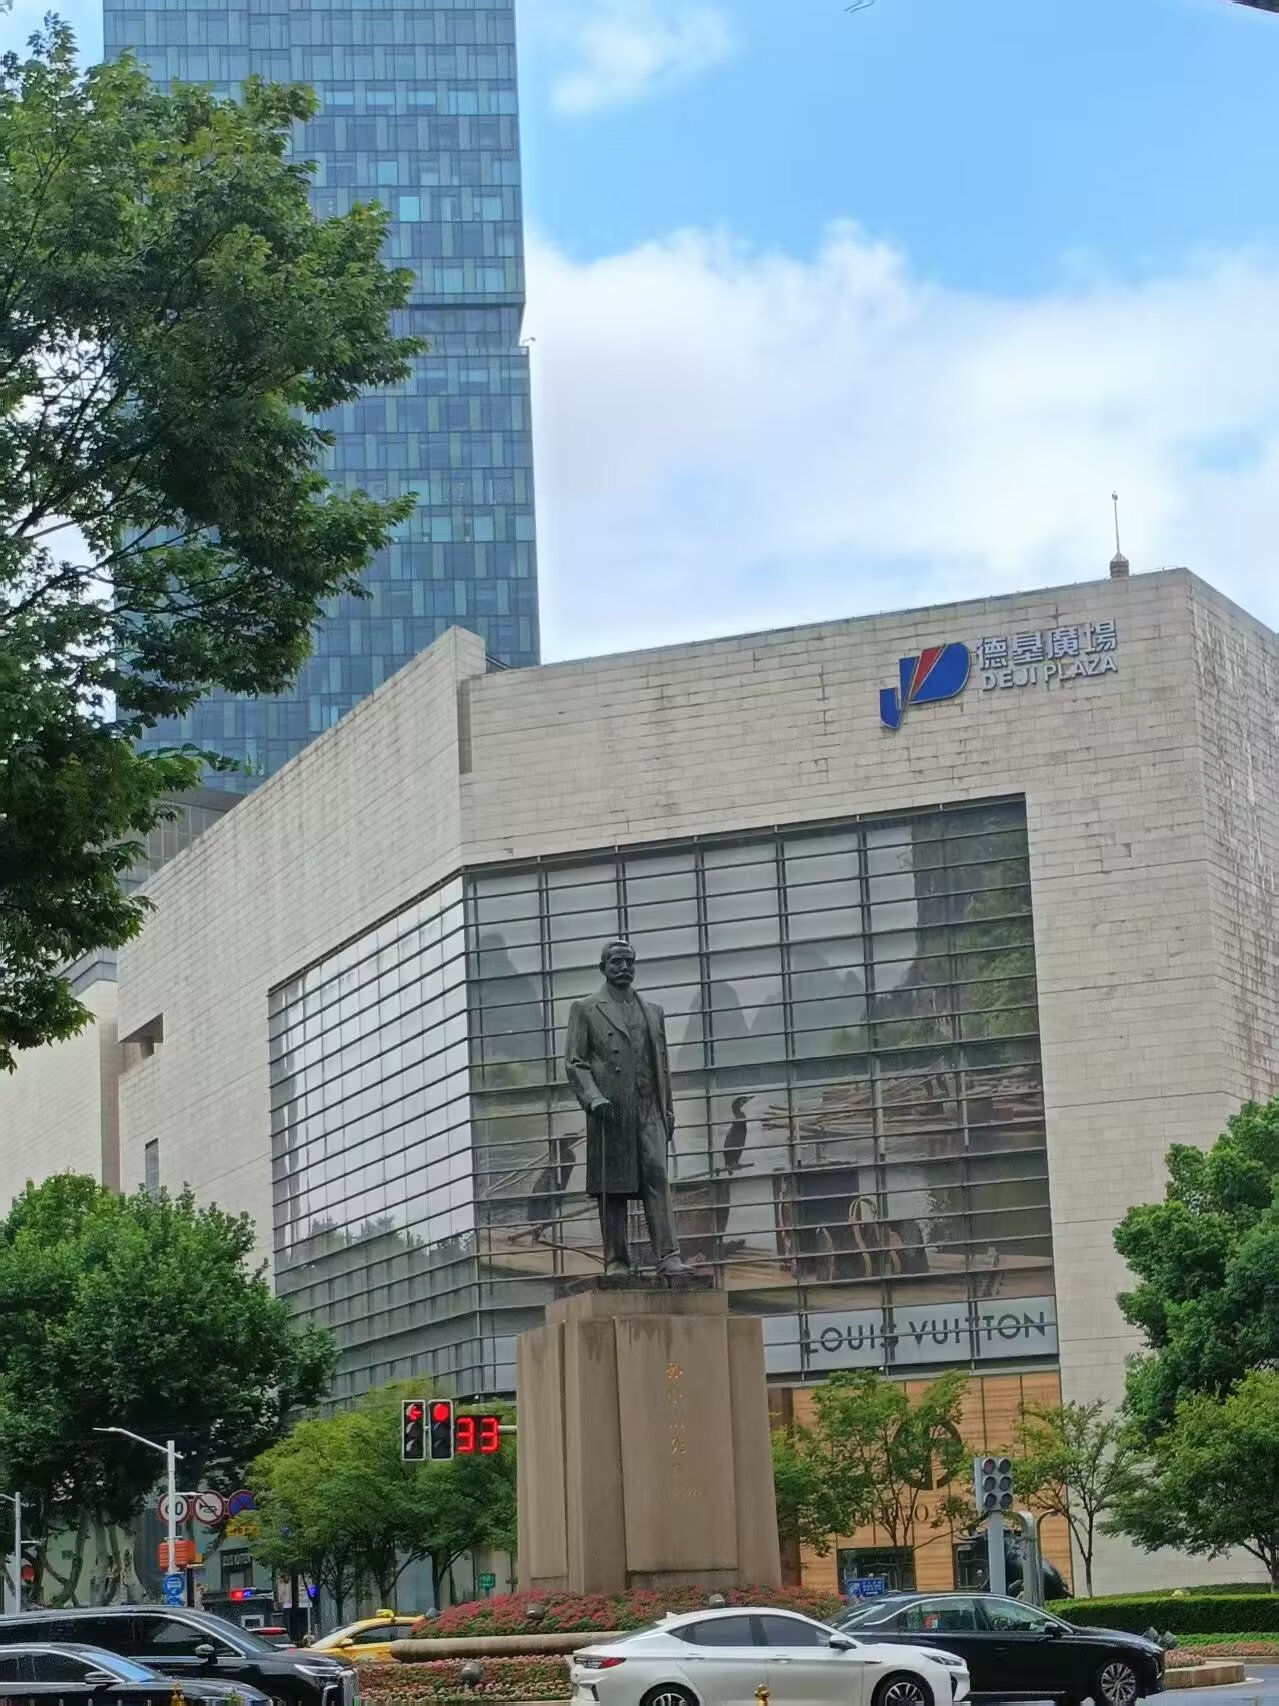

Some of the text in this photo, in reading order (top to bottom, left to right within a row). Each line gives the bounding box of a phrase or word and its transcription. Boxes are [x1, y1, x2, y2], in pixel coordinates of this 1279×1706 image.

[983, 655, 1118, 691] DEJI PLAZA
[456, 1416, 499, 1455] 33
